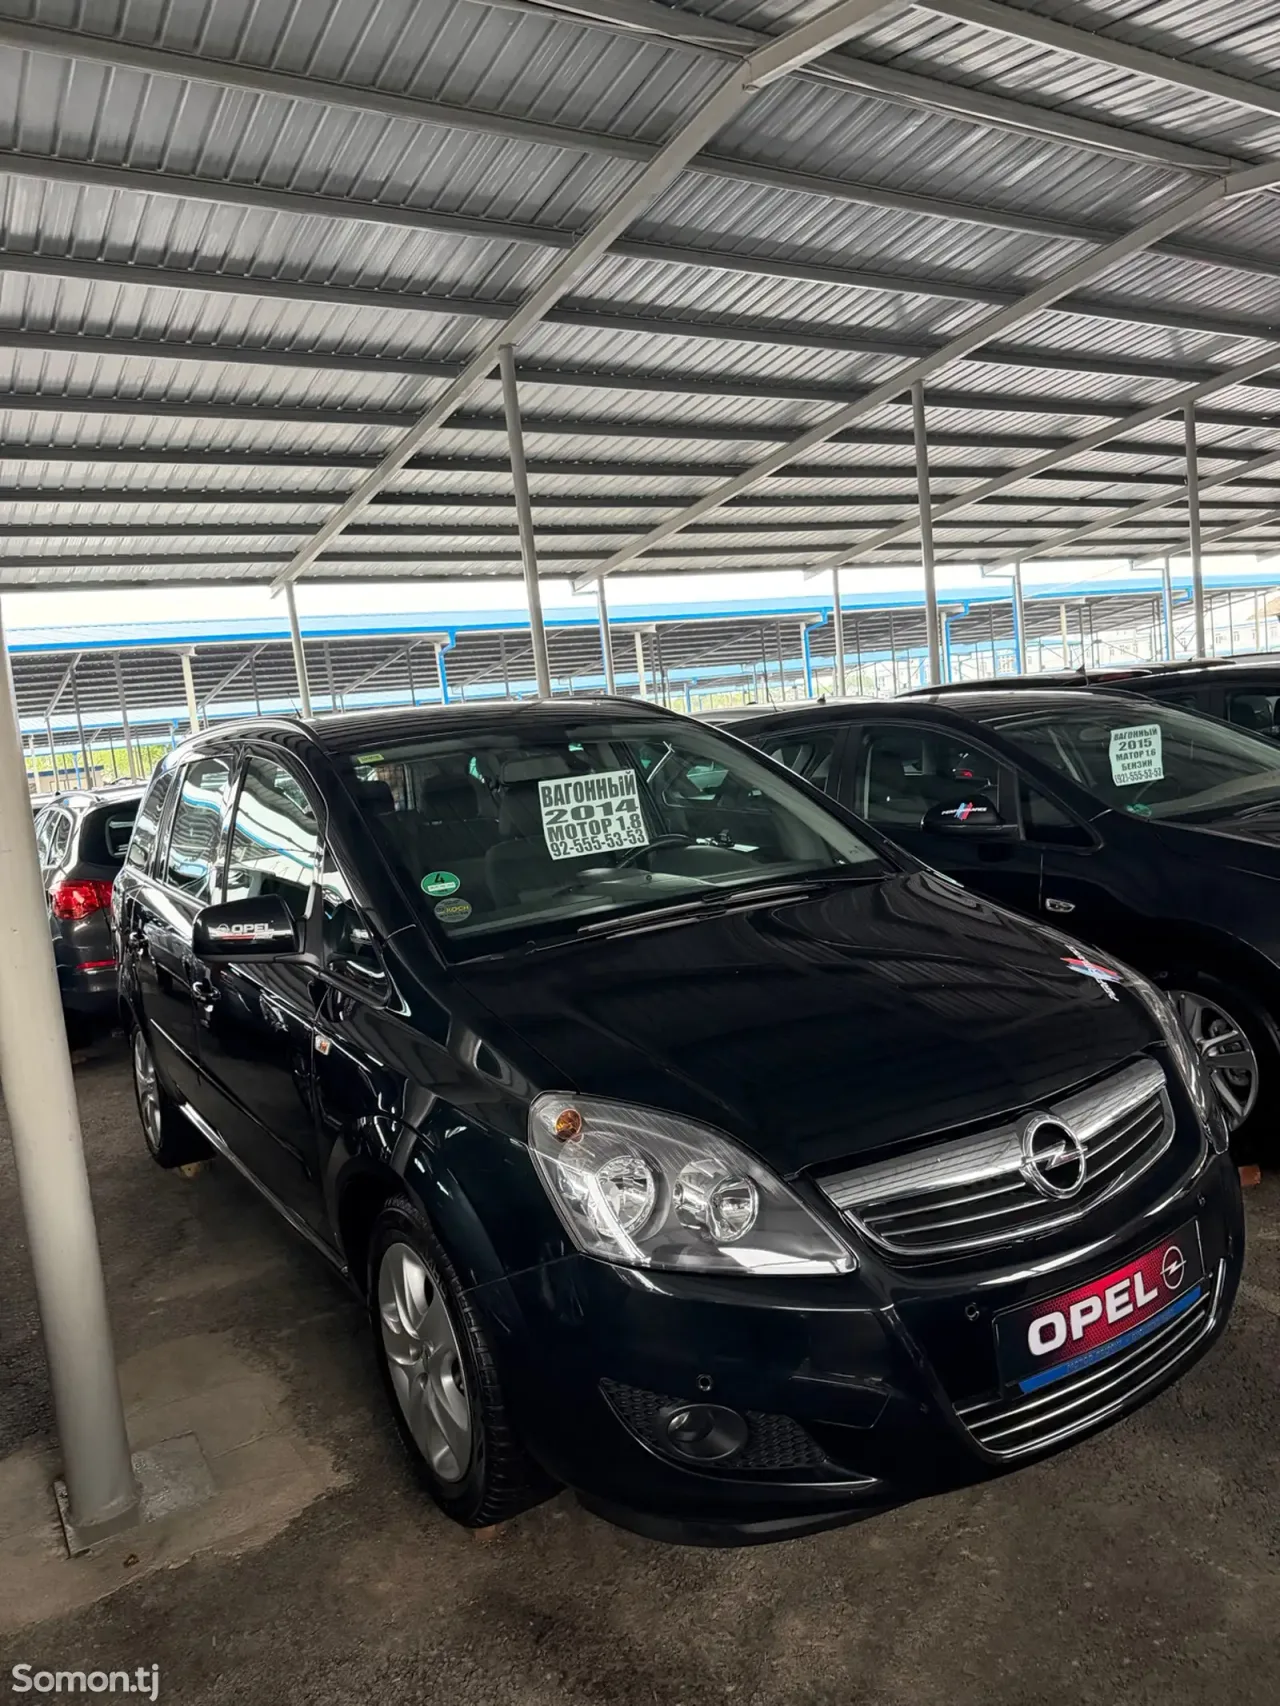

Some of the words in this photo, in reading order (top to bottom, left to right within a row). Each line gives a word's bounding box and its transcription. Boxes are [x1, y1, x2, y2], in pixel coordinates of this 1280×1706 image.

[1118, 738, 1152, 751] 2015
[1121, 759, 1153, 771] БЕНЗИН
[544, 798, 638, 825] 2014
[546, 818, 612, 842] МОТОР
[616, 813, 641, 831] 1.8
[550, 828, 645, 857] 92-555-53-53
[435, 873, 445, 883] 4
[231, 923, 274, 932] OPEL
[1027, 1271, 1158, 1356] OPEL
